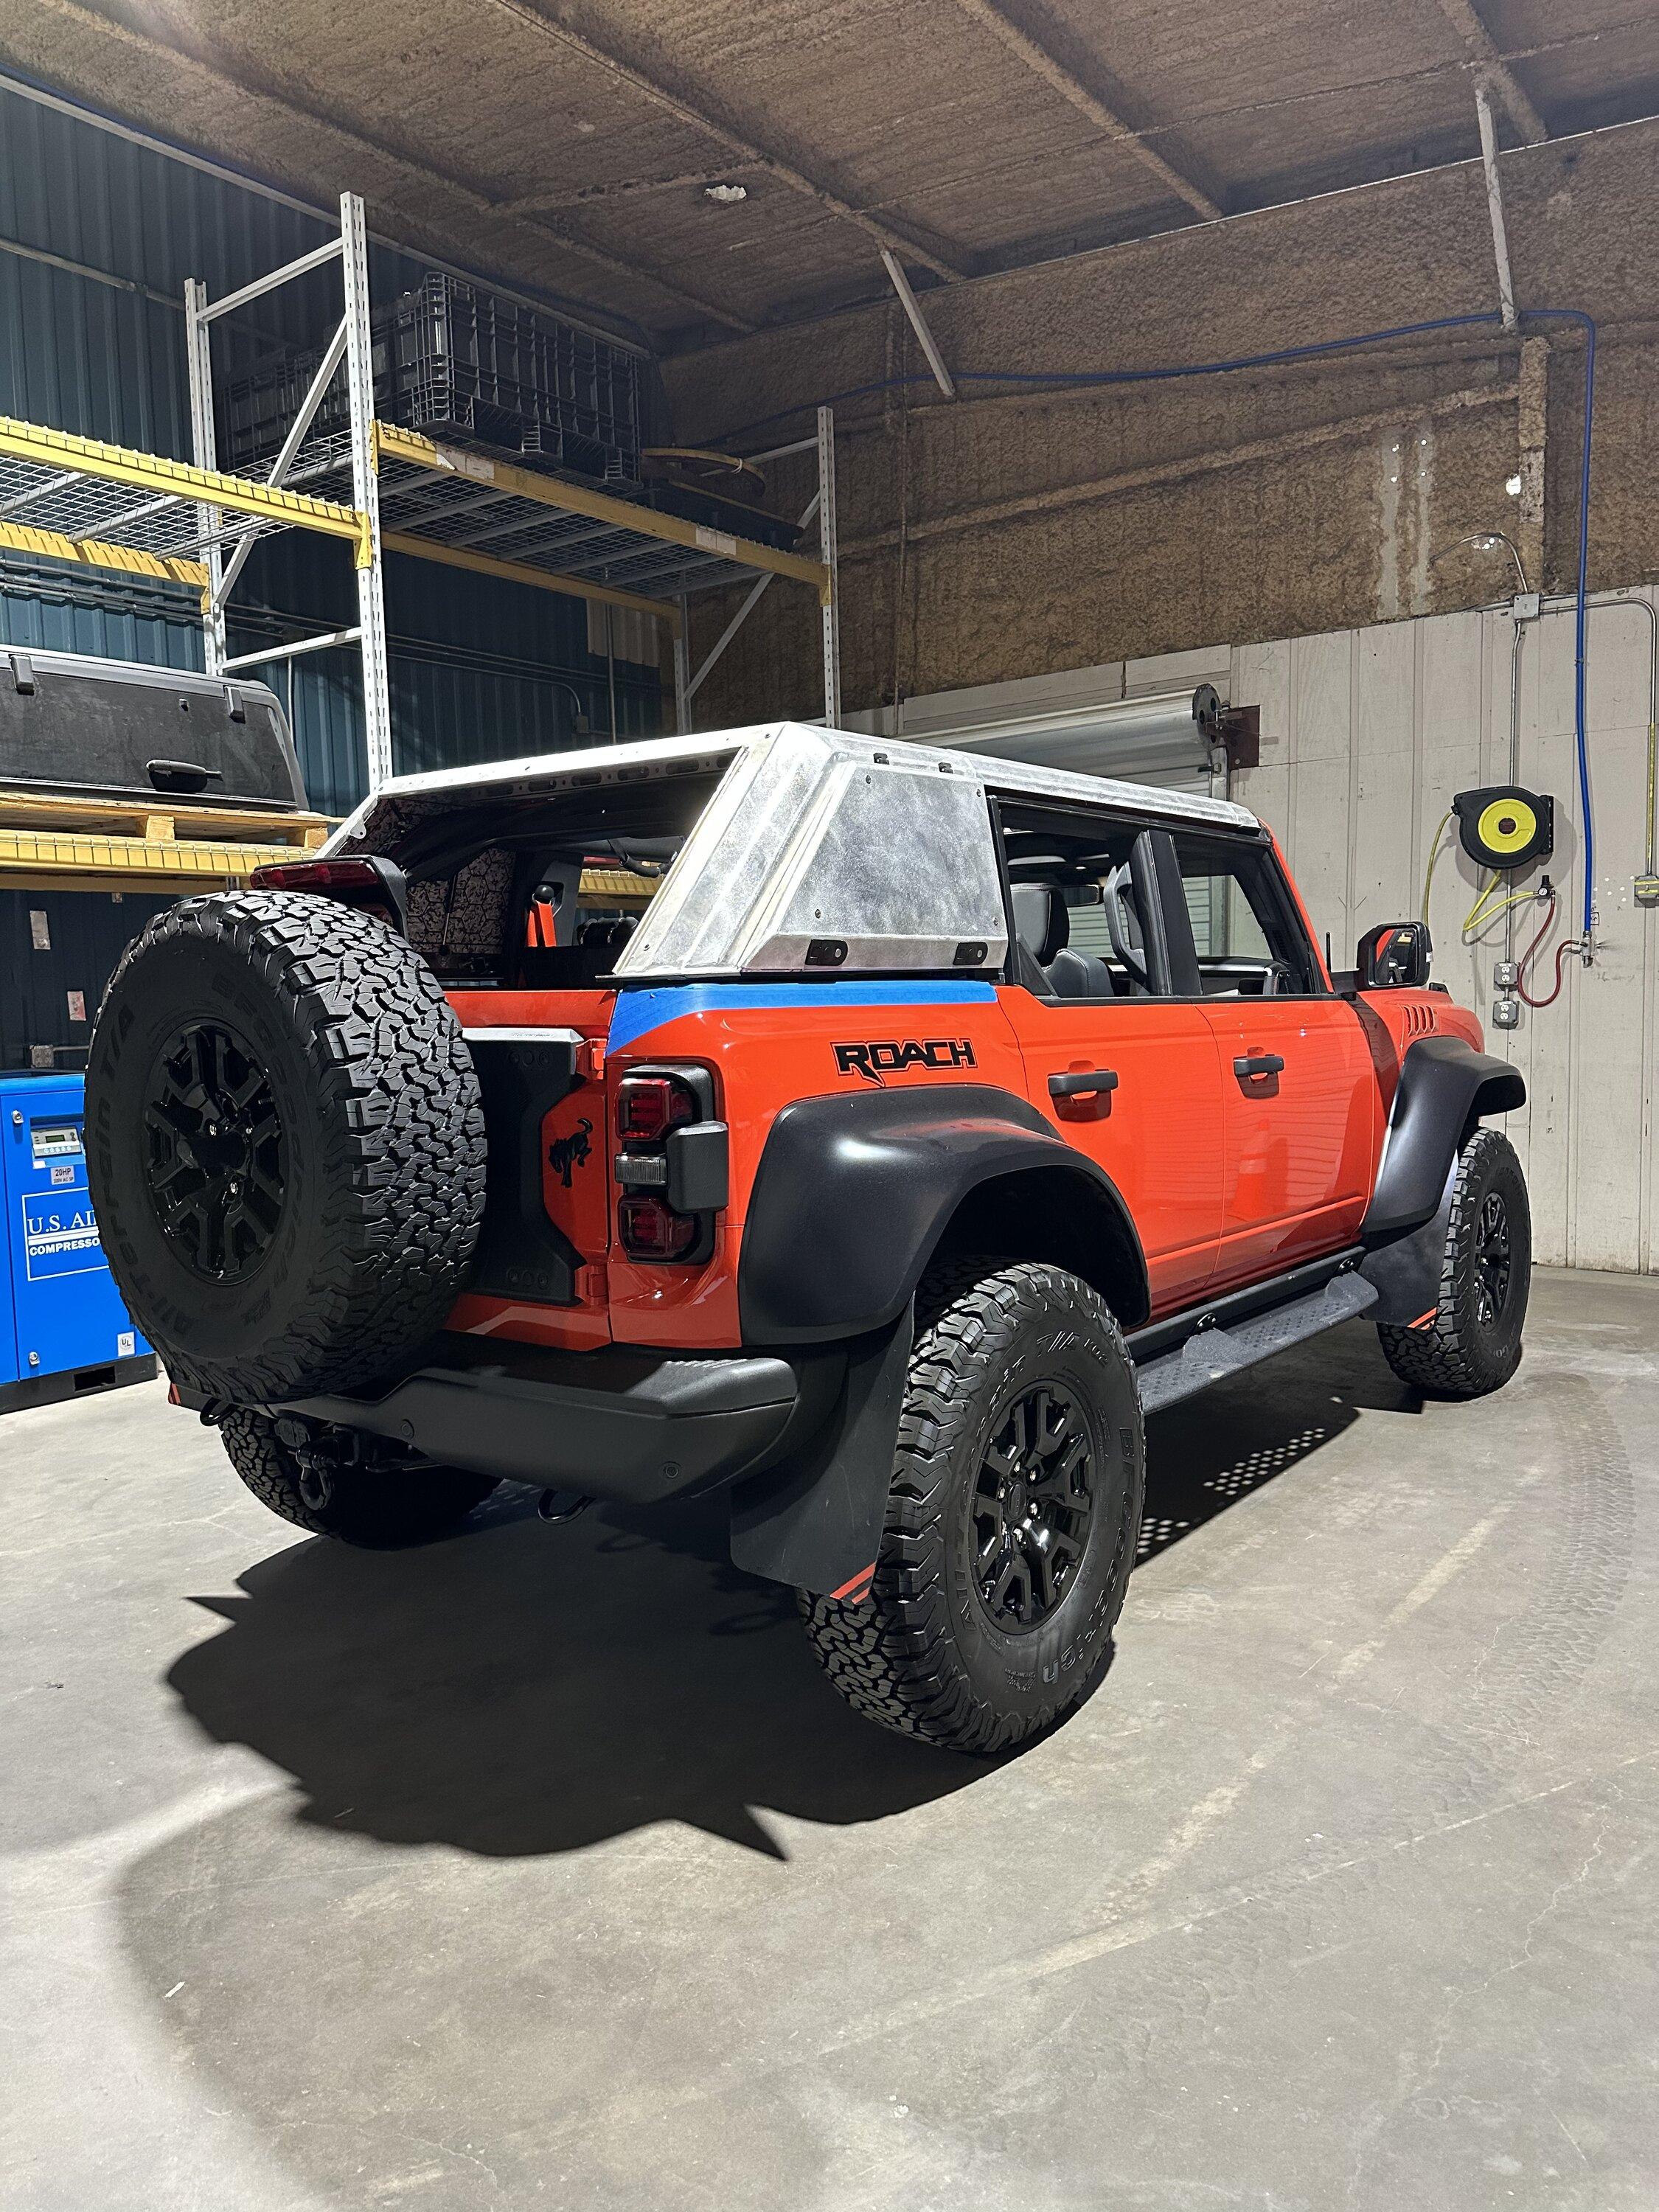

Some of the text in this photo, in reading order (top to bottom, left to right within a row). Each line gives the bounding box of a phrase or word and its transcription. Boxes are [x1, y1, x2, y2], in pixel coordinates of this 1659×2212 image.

[830, 1038, 978, 1088] ROACH
[55, 1167, 72, 1177] 20HP
[27, 1209, 97, 1235] U.S. AI
[122, 1338, 131, 1346] UL
